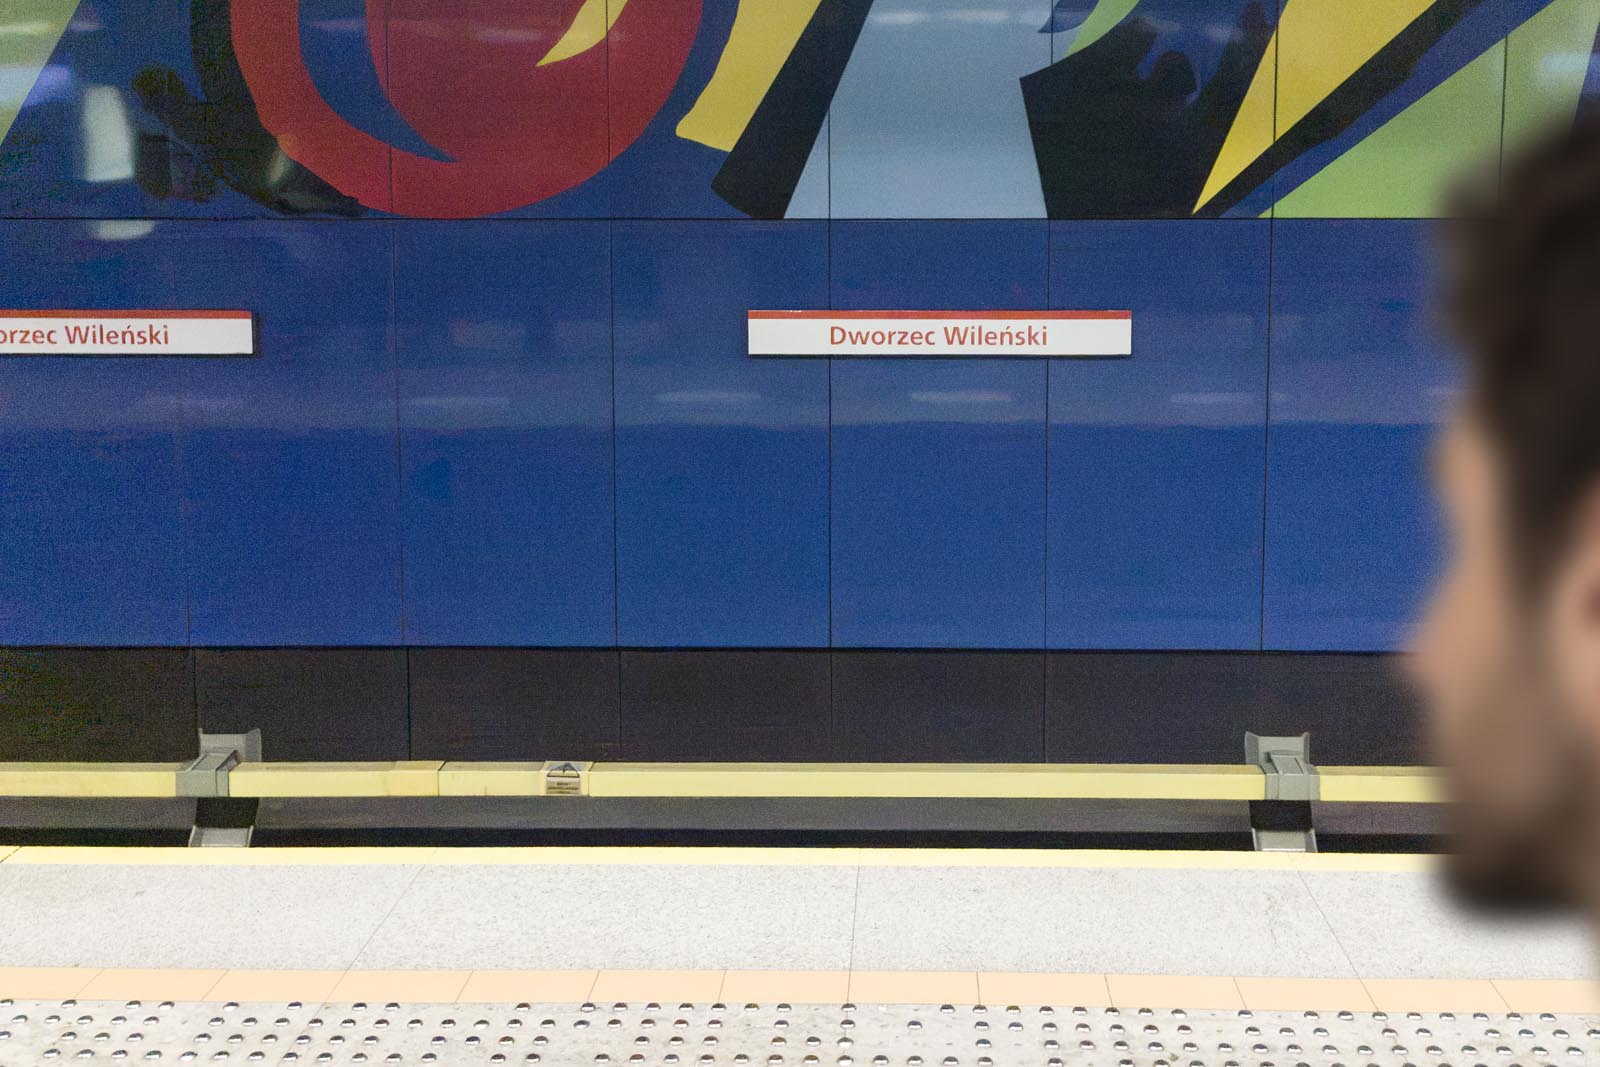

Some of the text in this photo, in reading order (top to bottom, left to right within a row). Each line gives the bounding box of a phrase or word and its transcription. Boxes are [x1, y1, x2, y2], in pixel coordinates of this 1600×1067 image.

[64, 324, 169, 344] Wileński
[831, 325, 1047, 345] Dworzec Wileński
